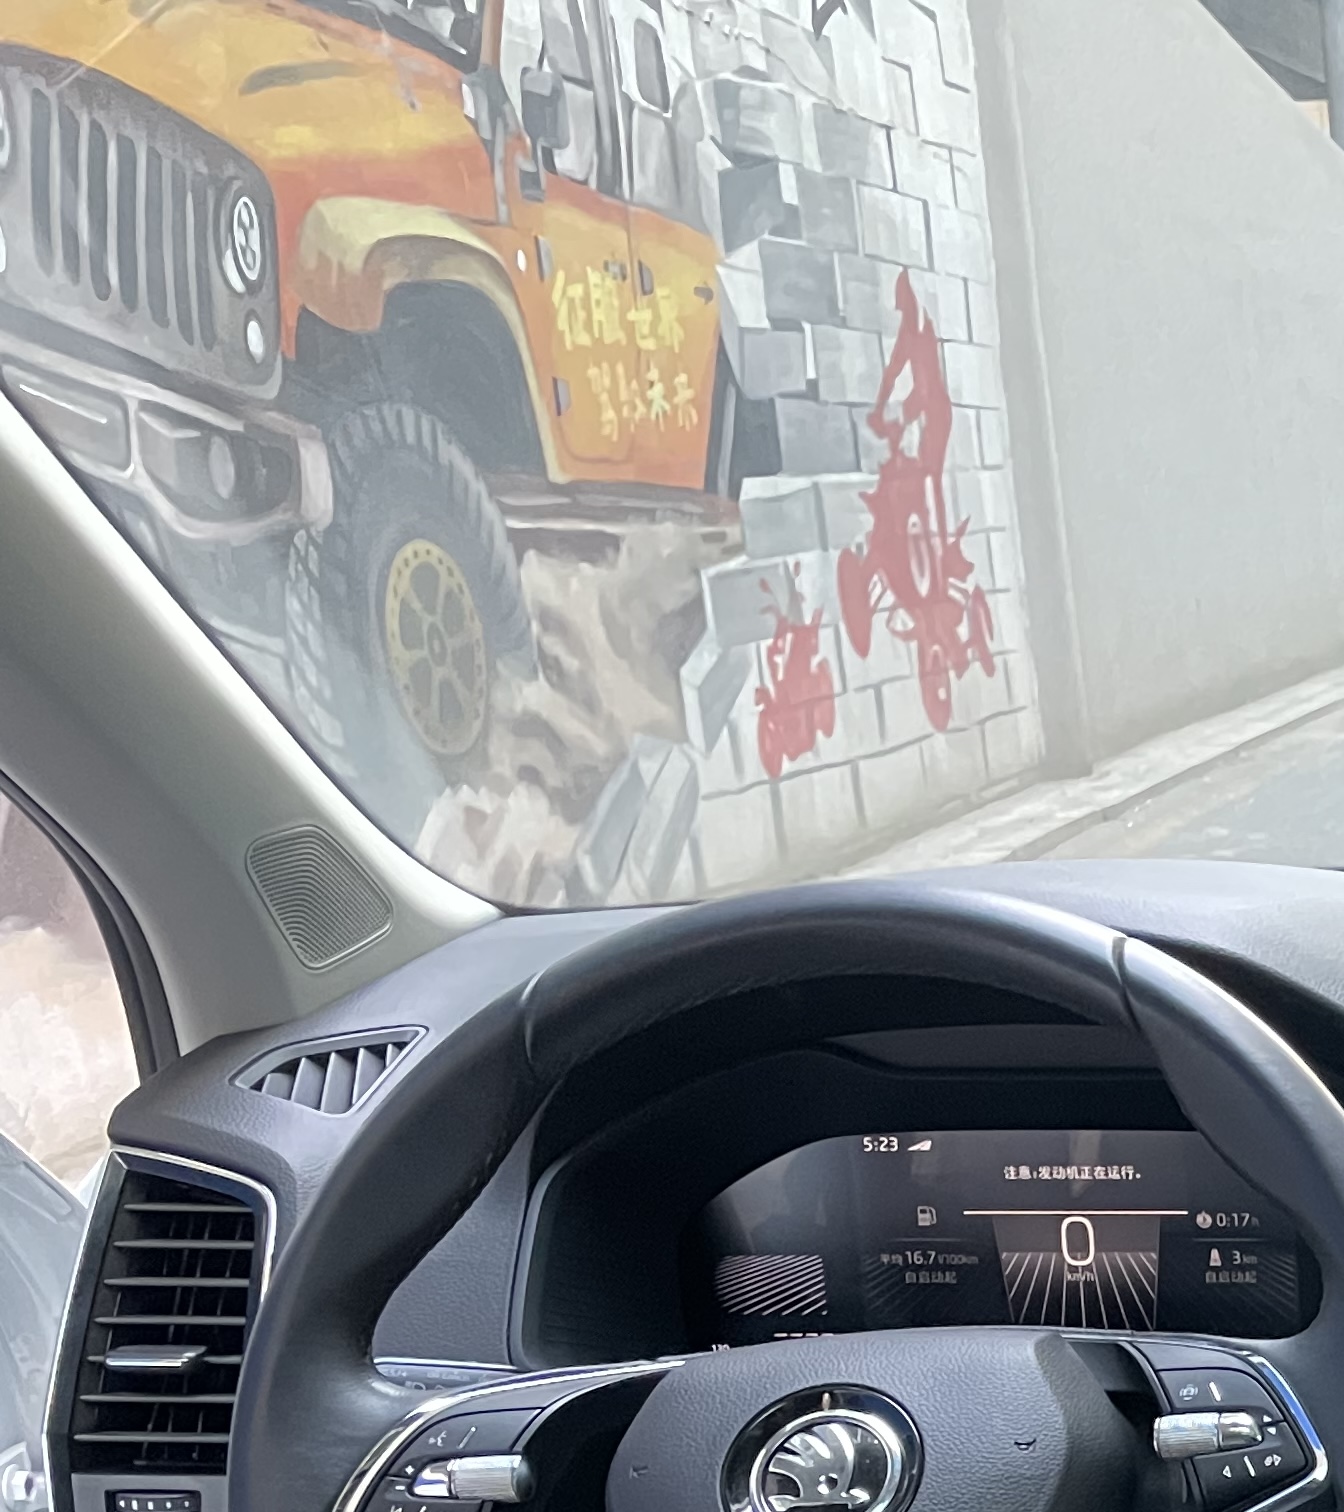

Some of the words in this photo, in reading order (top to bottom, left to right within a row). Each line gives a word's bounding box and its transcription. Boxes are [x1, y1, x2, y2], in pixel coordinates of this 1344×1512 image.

[551, 266, 685, 353] 征服世界
[862, 1136, 899, 1153] 5:23
[1216, 1212, 1250, 1227] 0:17
[1060, 1216, 1095, 1267] 0
[904, 1250, 936, 1266] 16.7
[1232, 1250, 1241, 1265] 3
